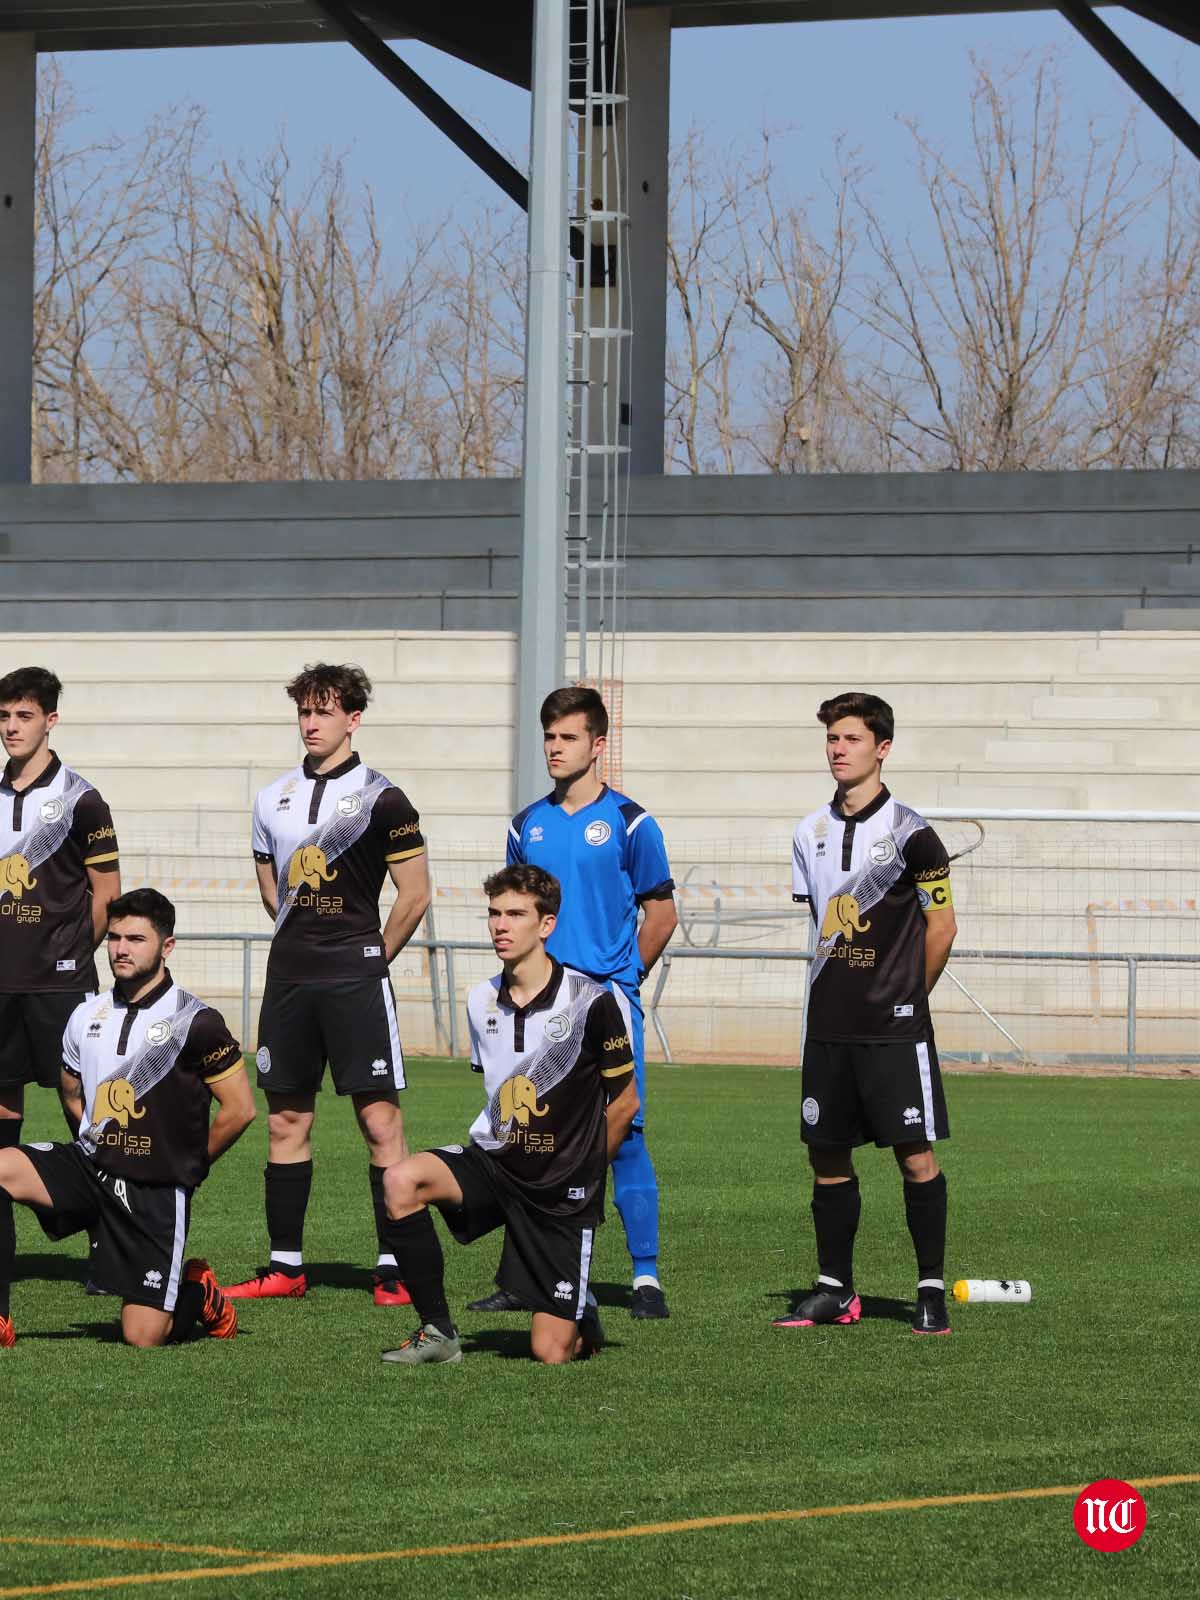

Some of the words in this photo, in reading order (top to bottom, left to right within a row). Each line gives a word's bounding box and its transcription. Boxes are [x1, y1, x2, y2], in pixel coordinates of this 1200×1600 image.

[932, 887, 947, 905] C
[316, 906, 343, 915] grupo
[16, 915, 41, 924] grupo
[849, 959, 875, 968] grupo
[123, 1147, 151, 1156] grupo
[524, 1144, 554, 1153] grupo
